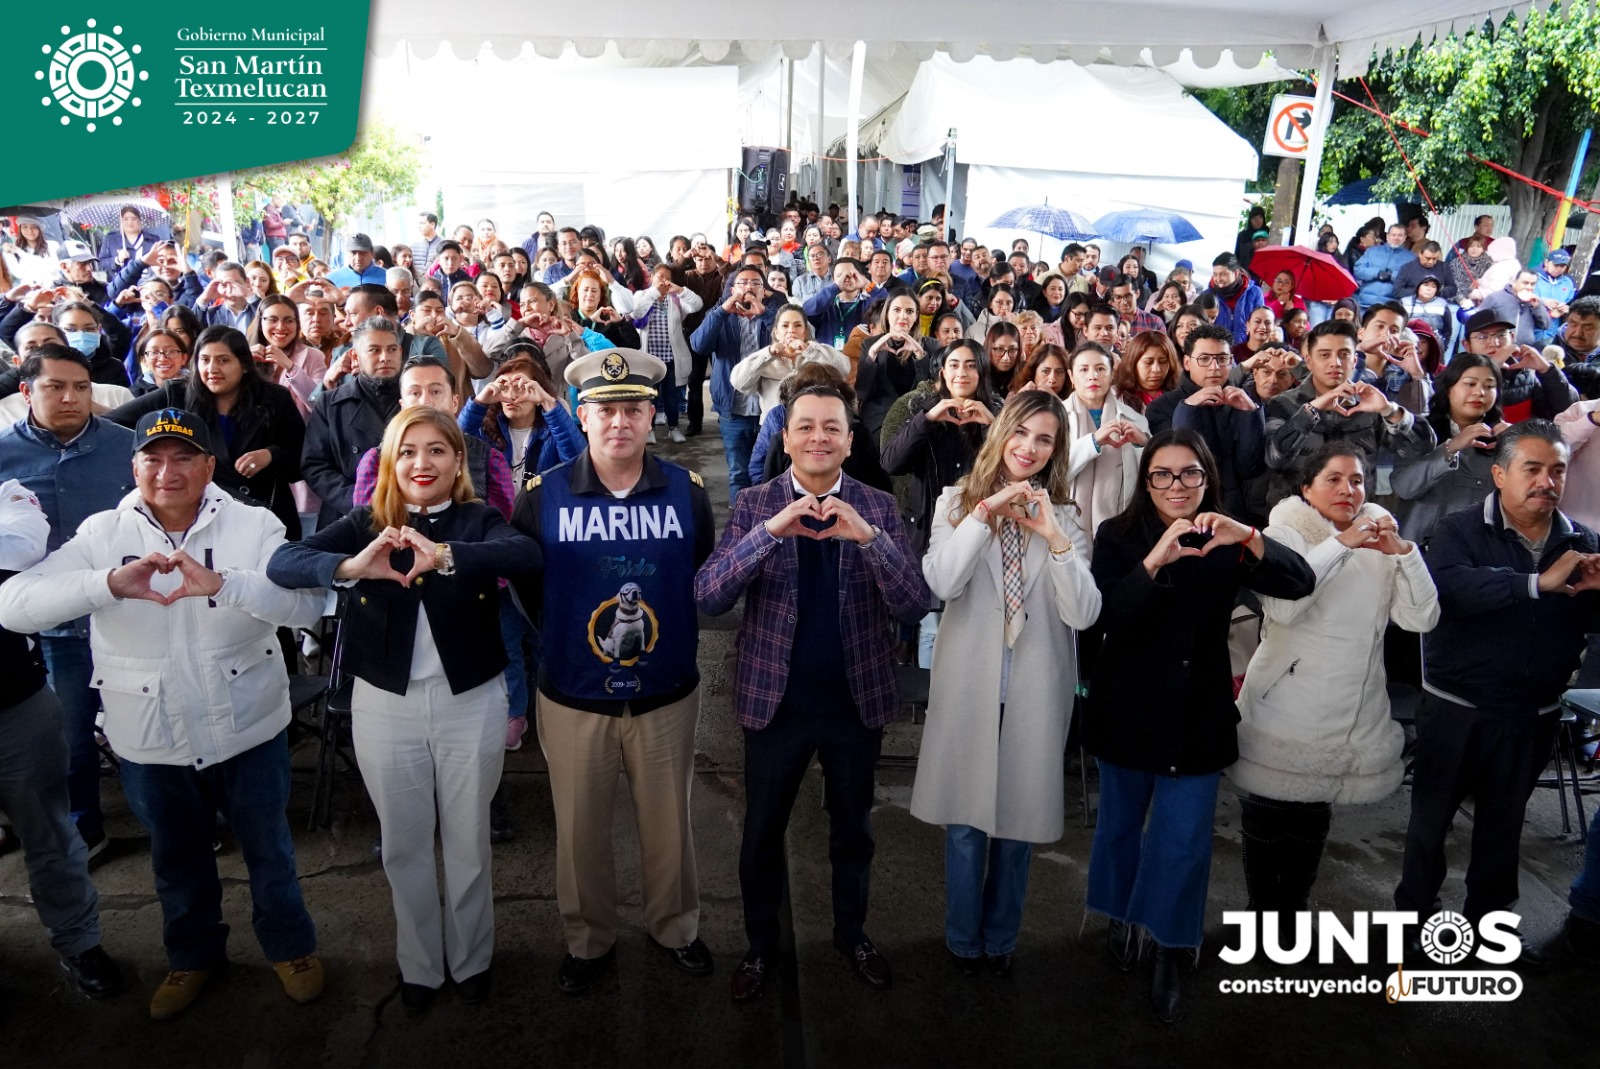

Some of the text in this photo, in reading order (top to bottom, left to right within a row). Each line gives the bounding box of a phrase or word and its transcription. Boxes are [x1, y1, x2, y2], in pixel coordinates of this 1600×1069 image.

[156, 410, 184, 425] LV
[146, 425, 193, 436] LAS VEGAS
[559, 505, 683, 542] MARINA
